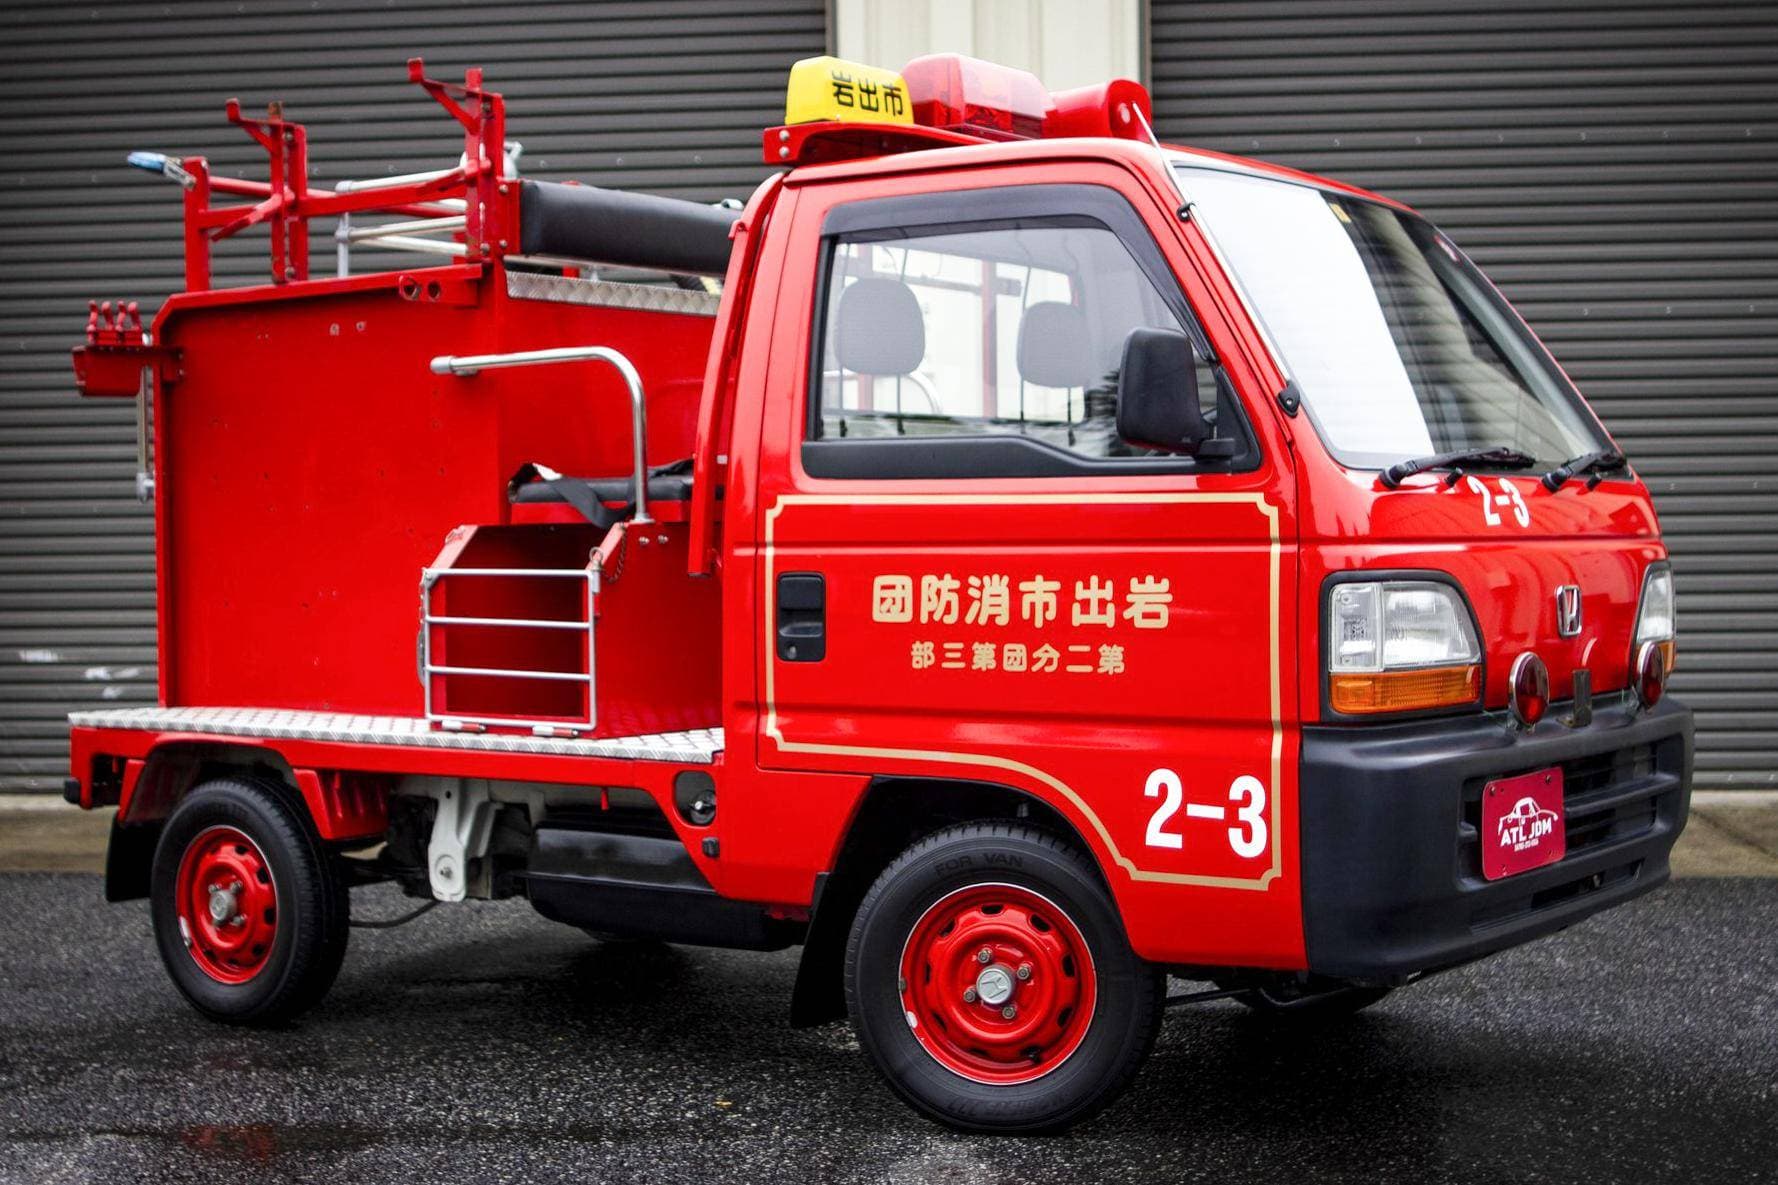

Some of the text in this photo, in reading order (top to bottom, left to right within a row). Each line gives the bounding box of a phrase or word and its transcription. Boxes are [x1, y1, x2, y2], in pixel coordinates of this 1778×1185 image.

[832, 69, 904, 117] 岩出市
[1467, 475, 1530, 528] 2-3
[1144, 768, 1268, 858] 2-3
[1500, 826, 1527, 847] ATL
[1528, 817, 1552, 839] JDM
[934, 852, 1024, 875] FOR VAN
